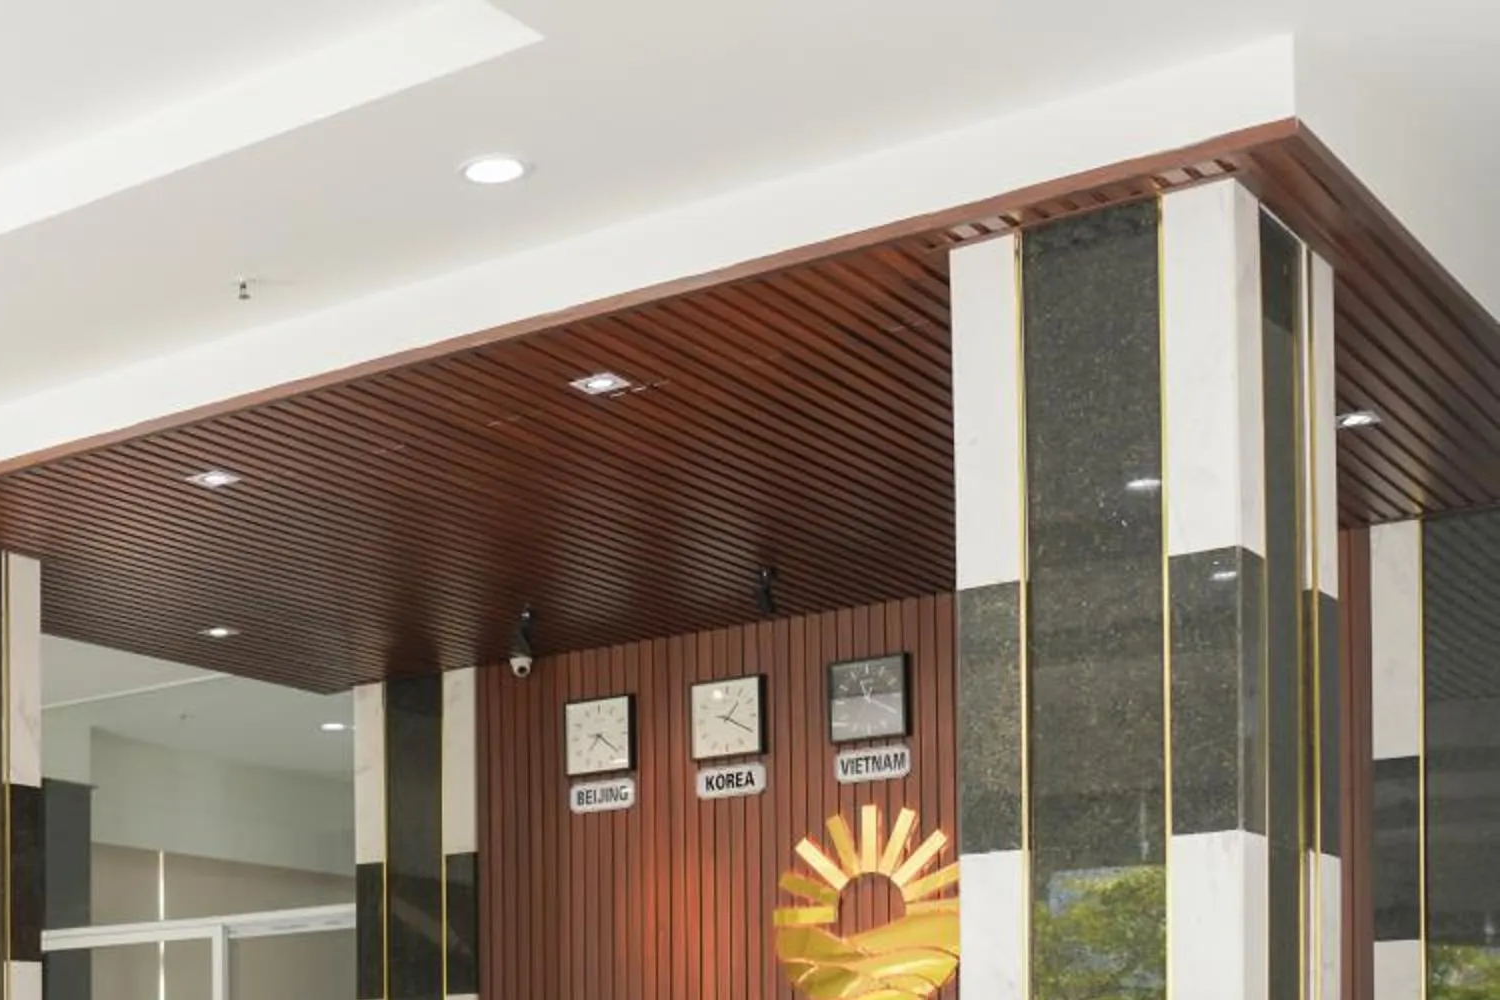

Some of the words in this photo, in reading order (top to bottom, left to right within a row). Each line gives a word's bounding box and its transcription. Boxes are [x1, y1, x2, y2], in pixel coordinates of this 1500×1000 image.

[841, 752, 906, 775] VIETNAM
[705, 770, 755, 792] KOREA
[577, 785, 629, 806] BEIJING
